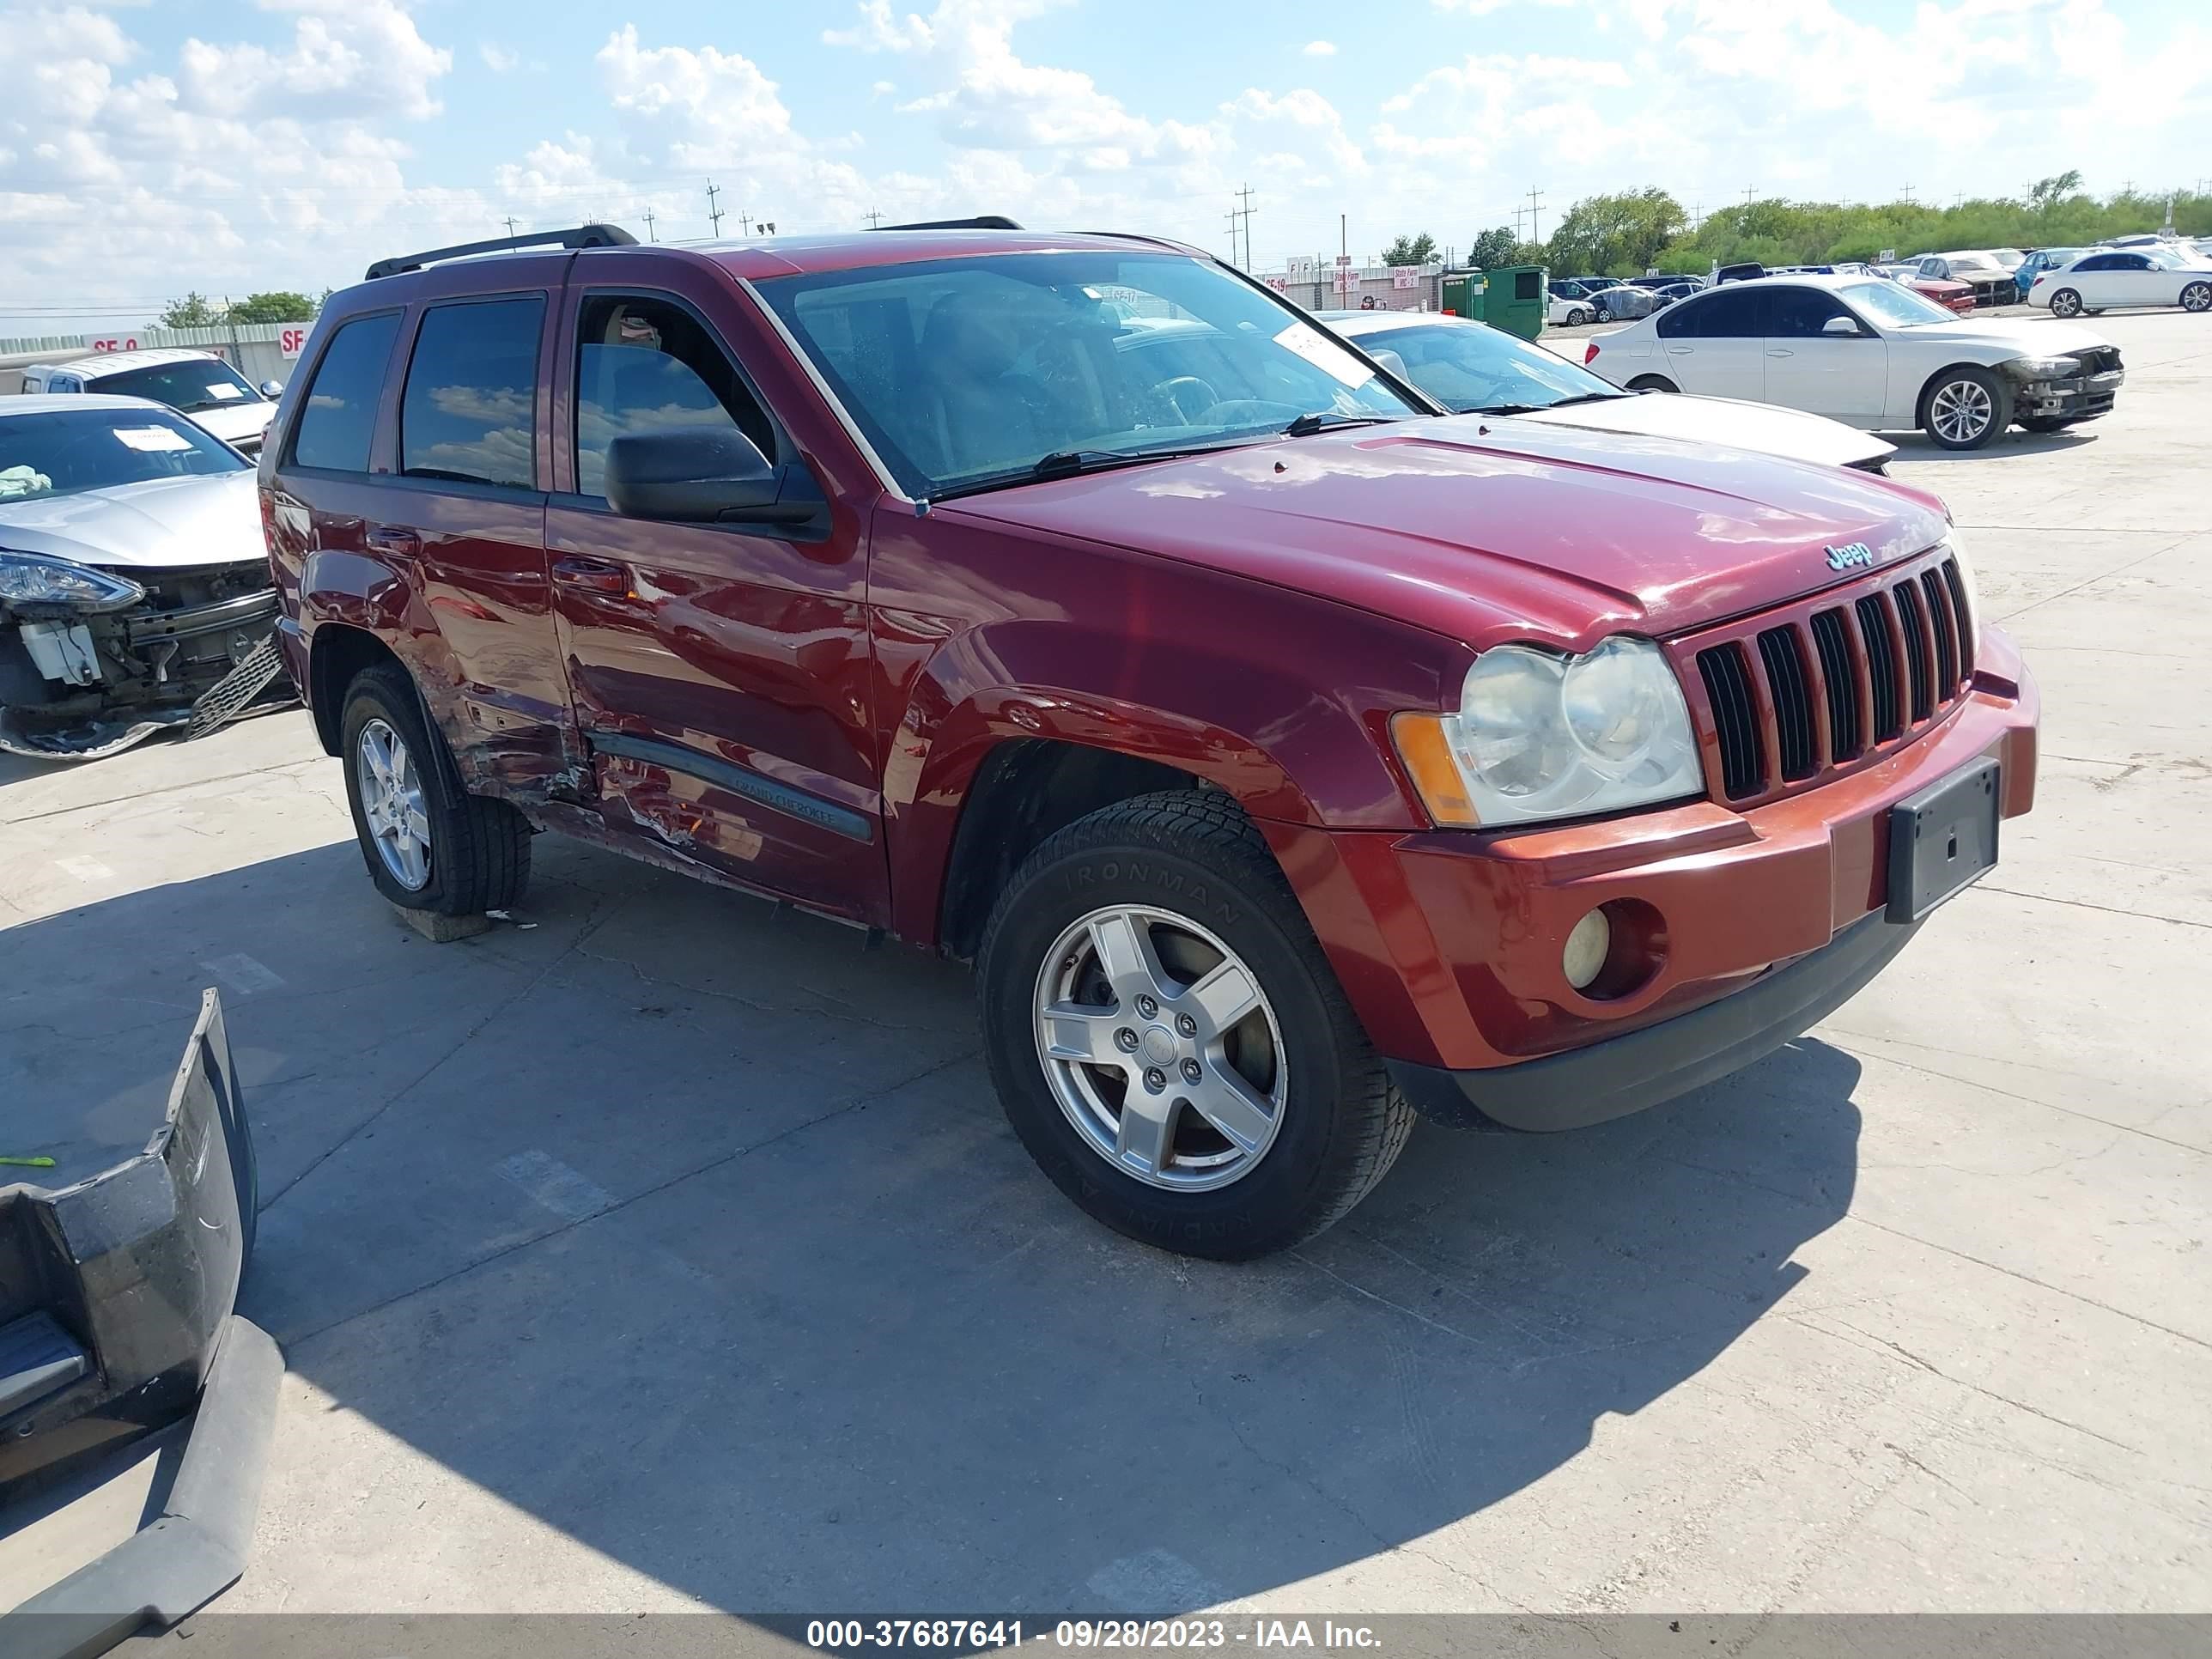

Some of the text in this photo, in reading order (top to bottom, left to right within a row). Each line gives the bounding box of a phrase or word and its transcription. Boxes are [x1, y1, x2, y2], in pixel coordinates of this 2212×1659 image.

[1823, 543, 1872, 571] Jeep
[775, 795, 836, 823] CHEROKEE
[1065, 862, 1239, 925] IRONMAN
